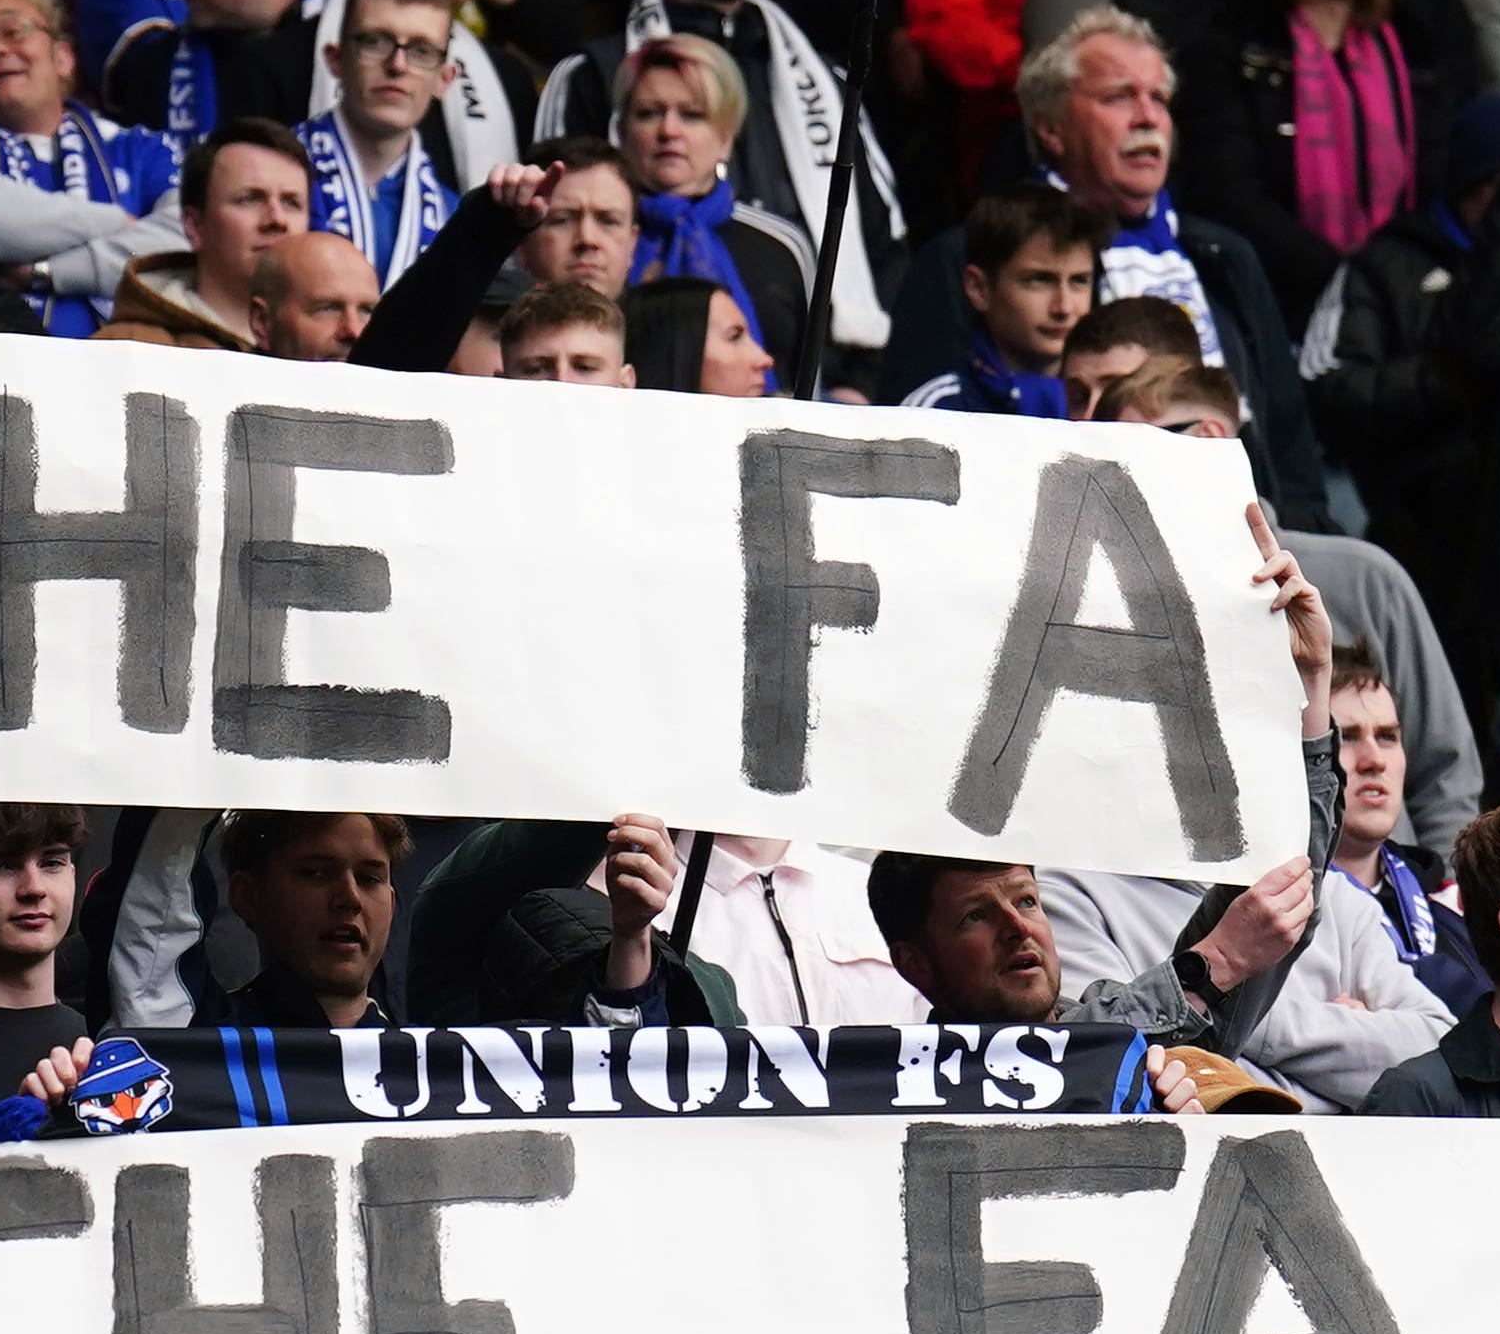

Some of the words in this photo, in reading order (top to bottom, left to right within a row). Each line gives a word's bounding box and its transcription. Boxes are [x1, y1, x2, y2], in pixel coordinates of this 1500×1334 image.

[739, 429, 1243, 864] FA
[331, 1024, 830, 1119] UNION
[884, 1021, 1072, 1112] FS
